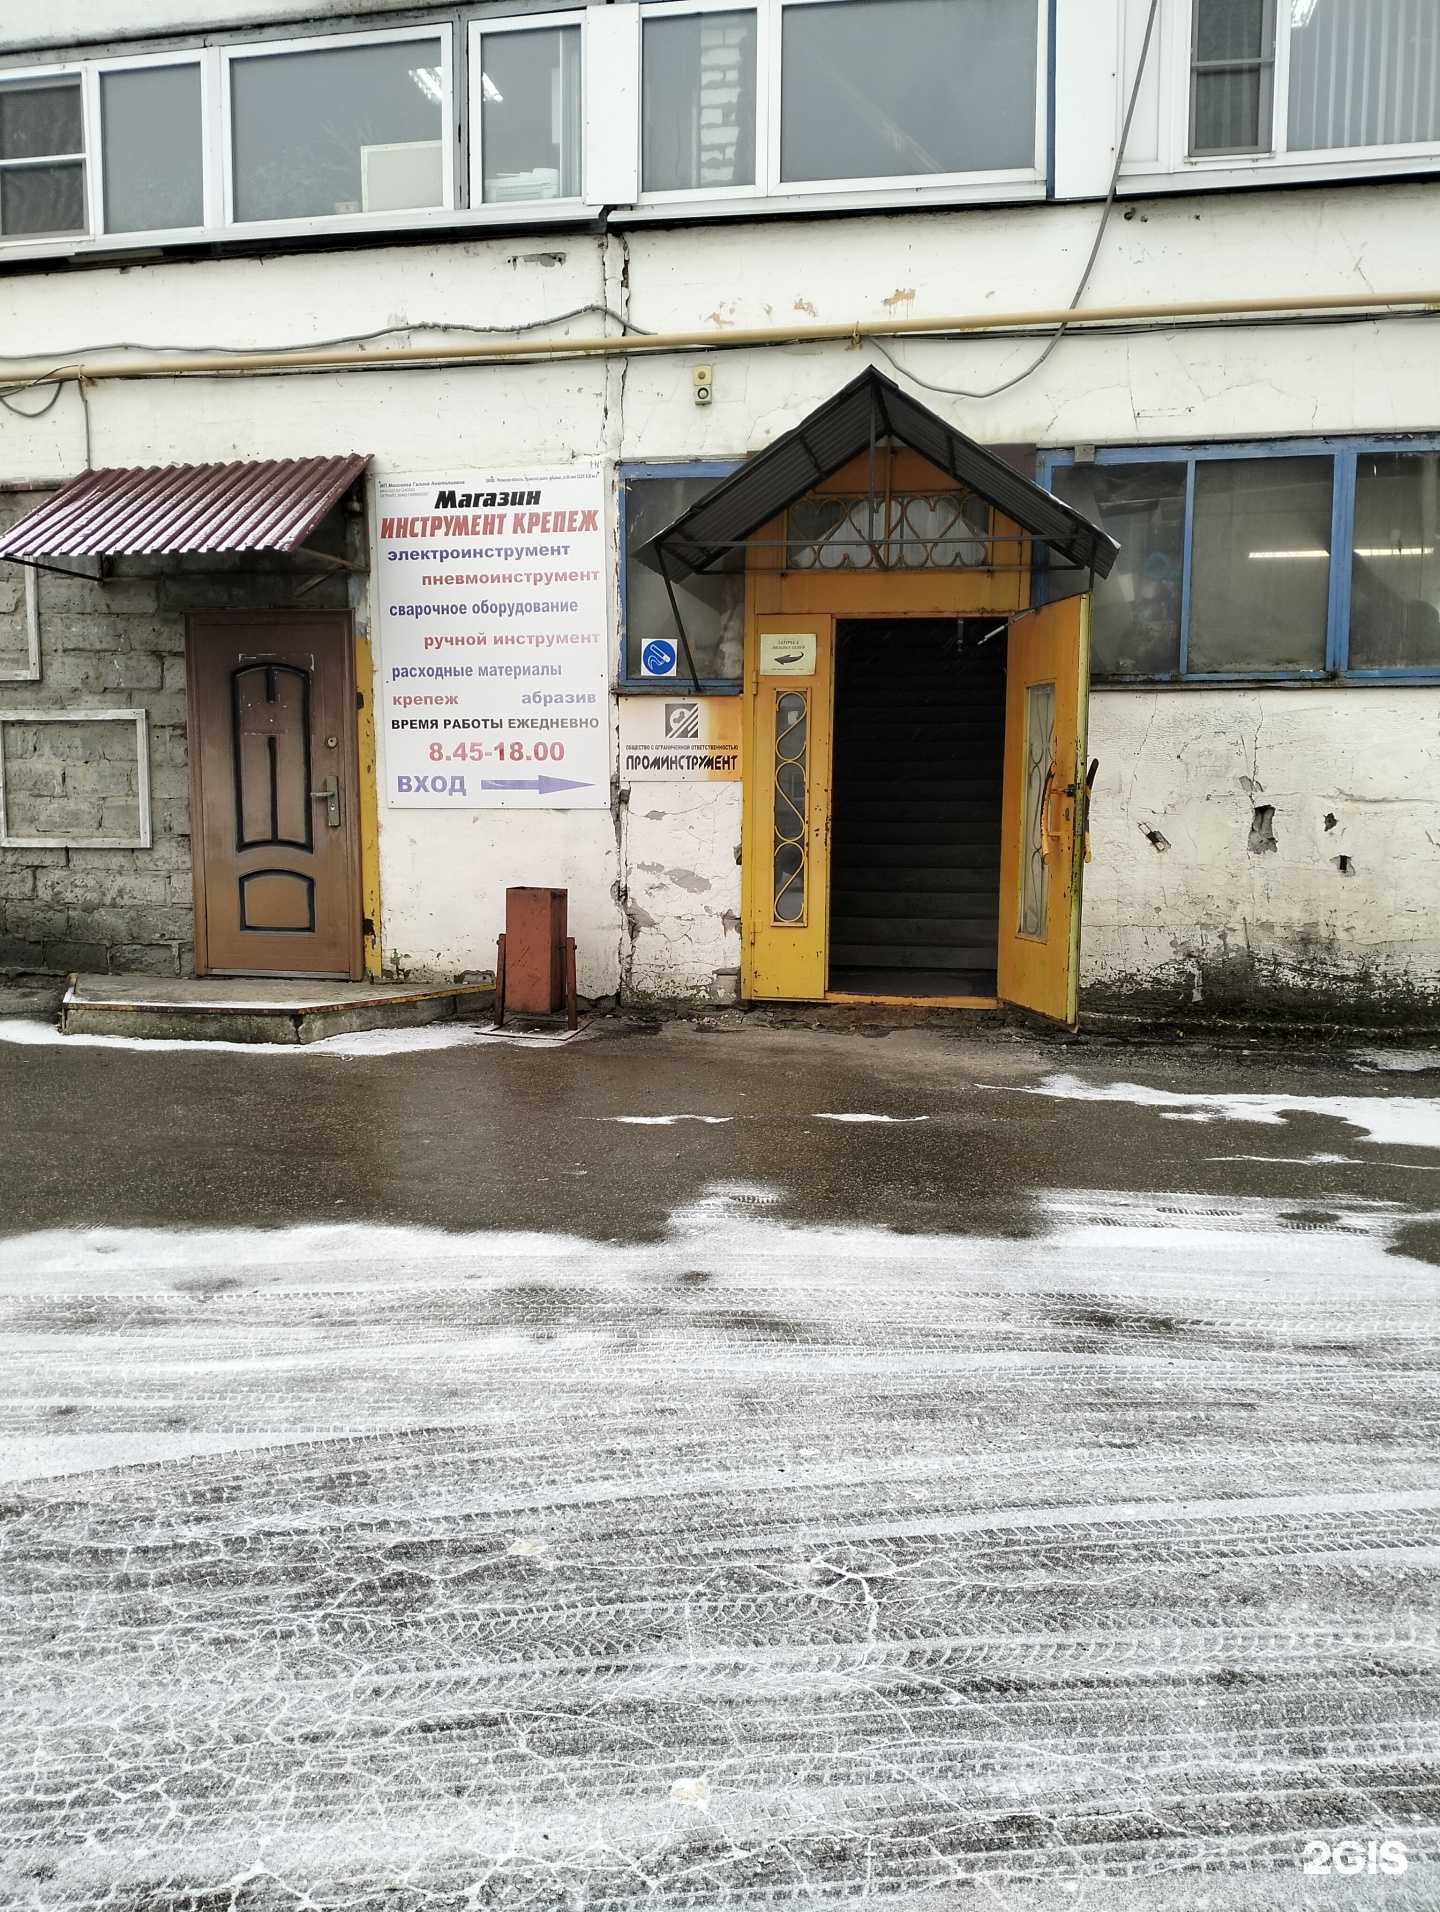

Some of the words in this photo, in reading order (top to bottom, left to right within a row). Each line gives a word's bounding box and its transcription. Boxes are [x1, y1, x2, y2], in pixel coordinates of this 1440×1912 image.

[434, 489, 542, 509] Магазин
[380, 513, 507, 539] ИНСТРУМЕНТ
[512, 509, 599, 534] КРЕПЕЖ
[387, 544, 571, 563] электроинструмент
[421, 568, 600, 587] пневмоинструмент
[389, 602, 467, 619] сварочное
[472, 598, 579, 617] оборудование
[424, 633, 487, 650] ручной
[493, 632, 601, 648] инструмент
[392, 664, 473, 681] расходные
[478, 662, 562, 679] материалы
[392, 694, 459, 708] крепеж
[521, 691, 597, 707] абразив
[391, 719, 439, 730] ВРЕМЯ
[443, 718, 503, 730] РАБОТЫ
[507, 717, 599, 730] ЕЖЕДНЕВНО
[428, 741, 565, 762] 8.45-18.00
[626, 755, 738, 770] ПРОМИНСТРУМЕНТ
[397, 775, 467, 796] ВХОД
